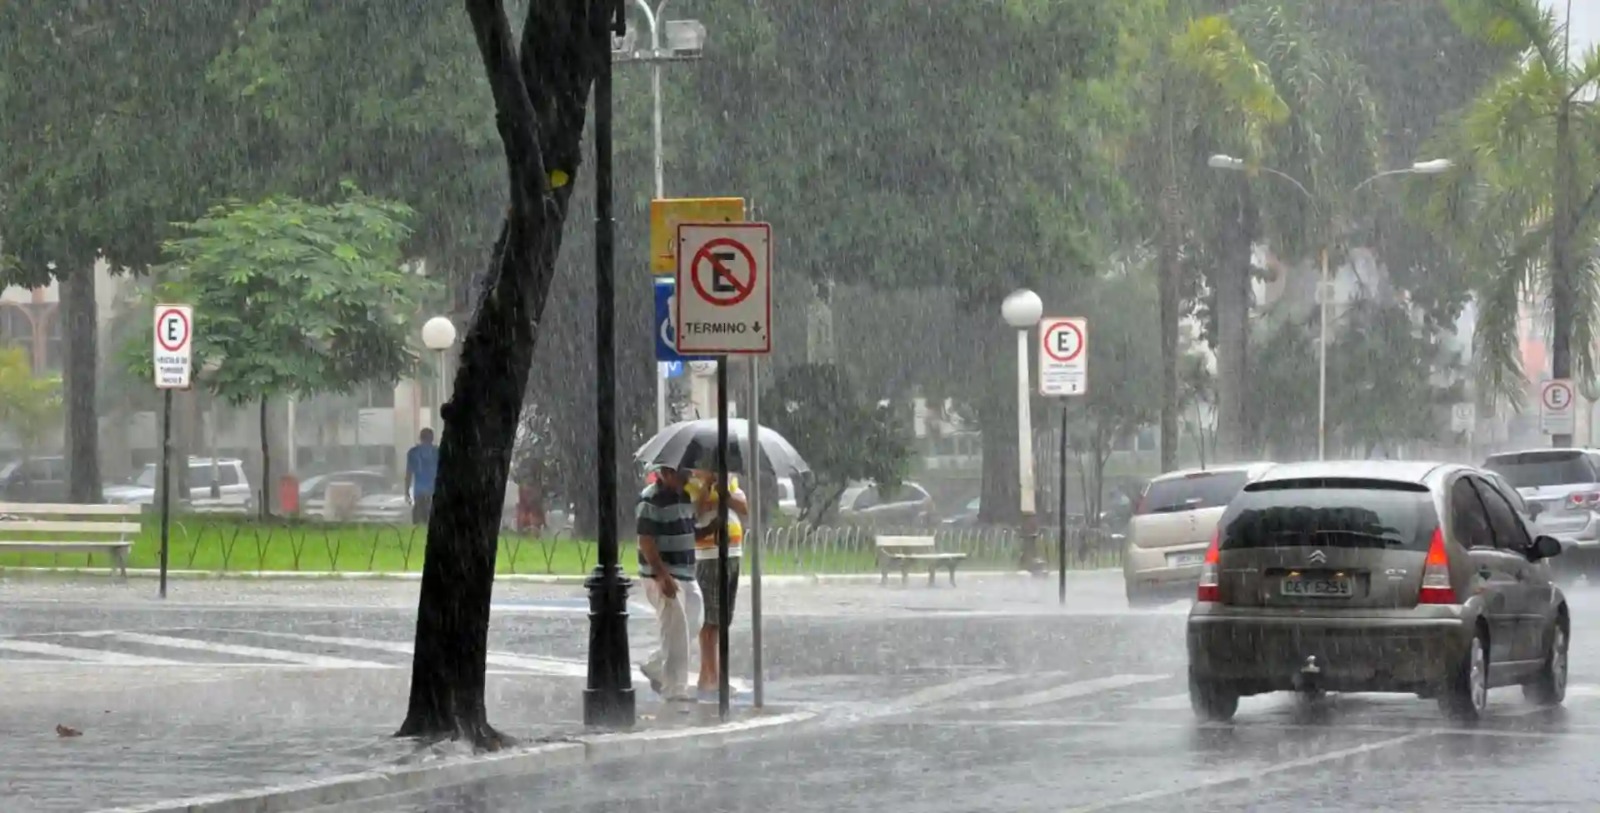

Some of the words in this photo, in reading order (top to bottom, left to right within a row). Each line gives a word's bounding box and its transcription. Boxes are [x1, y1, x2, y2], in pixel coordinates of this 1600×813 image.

[713, 253, 735, 292] E
[168, 318, 178, 340] E
[685, 322, 747, 334] TERMINO
[1058, 331, 1070, 351] E
[1552, 389, 1561, 404] E
